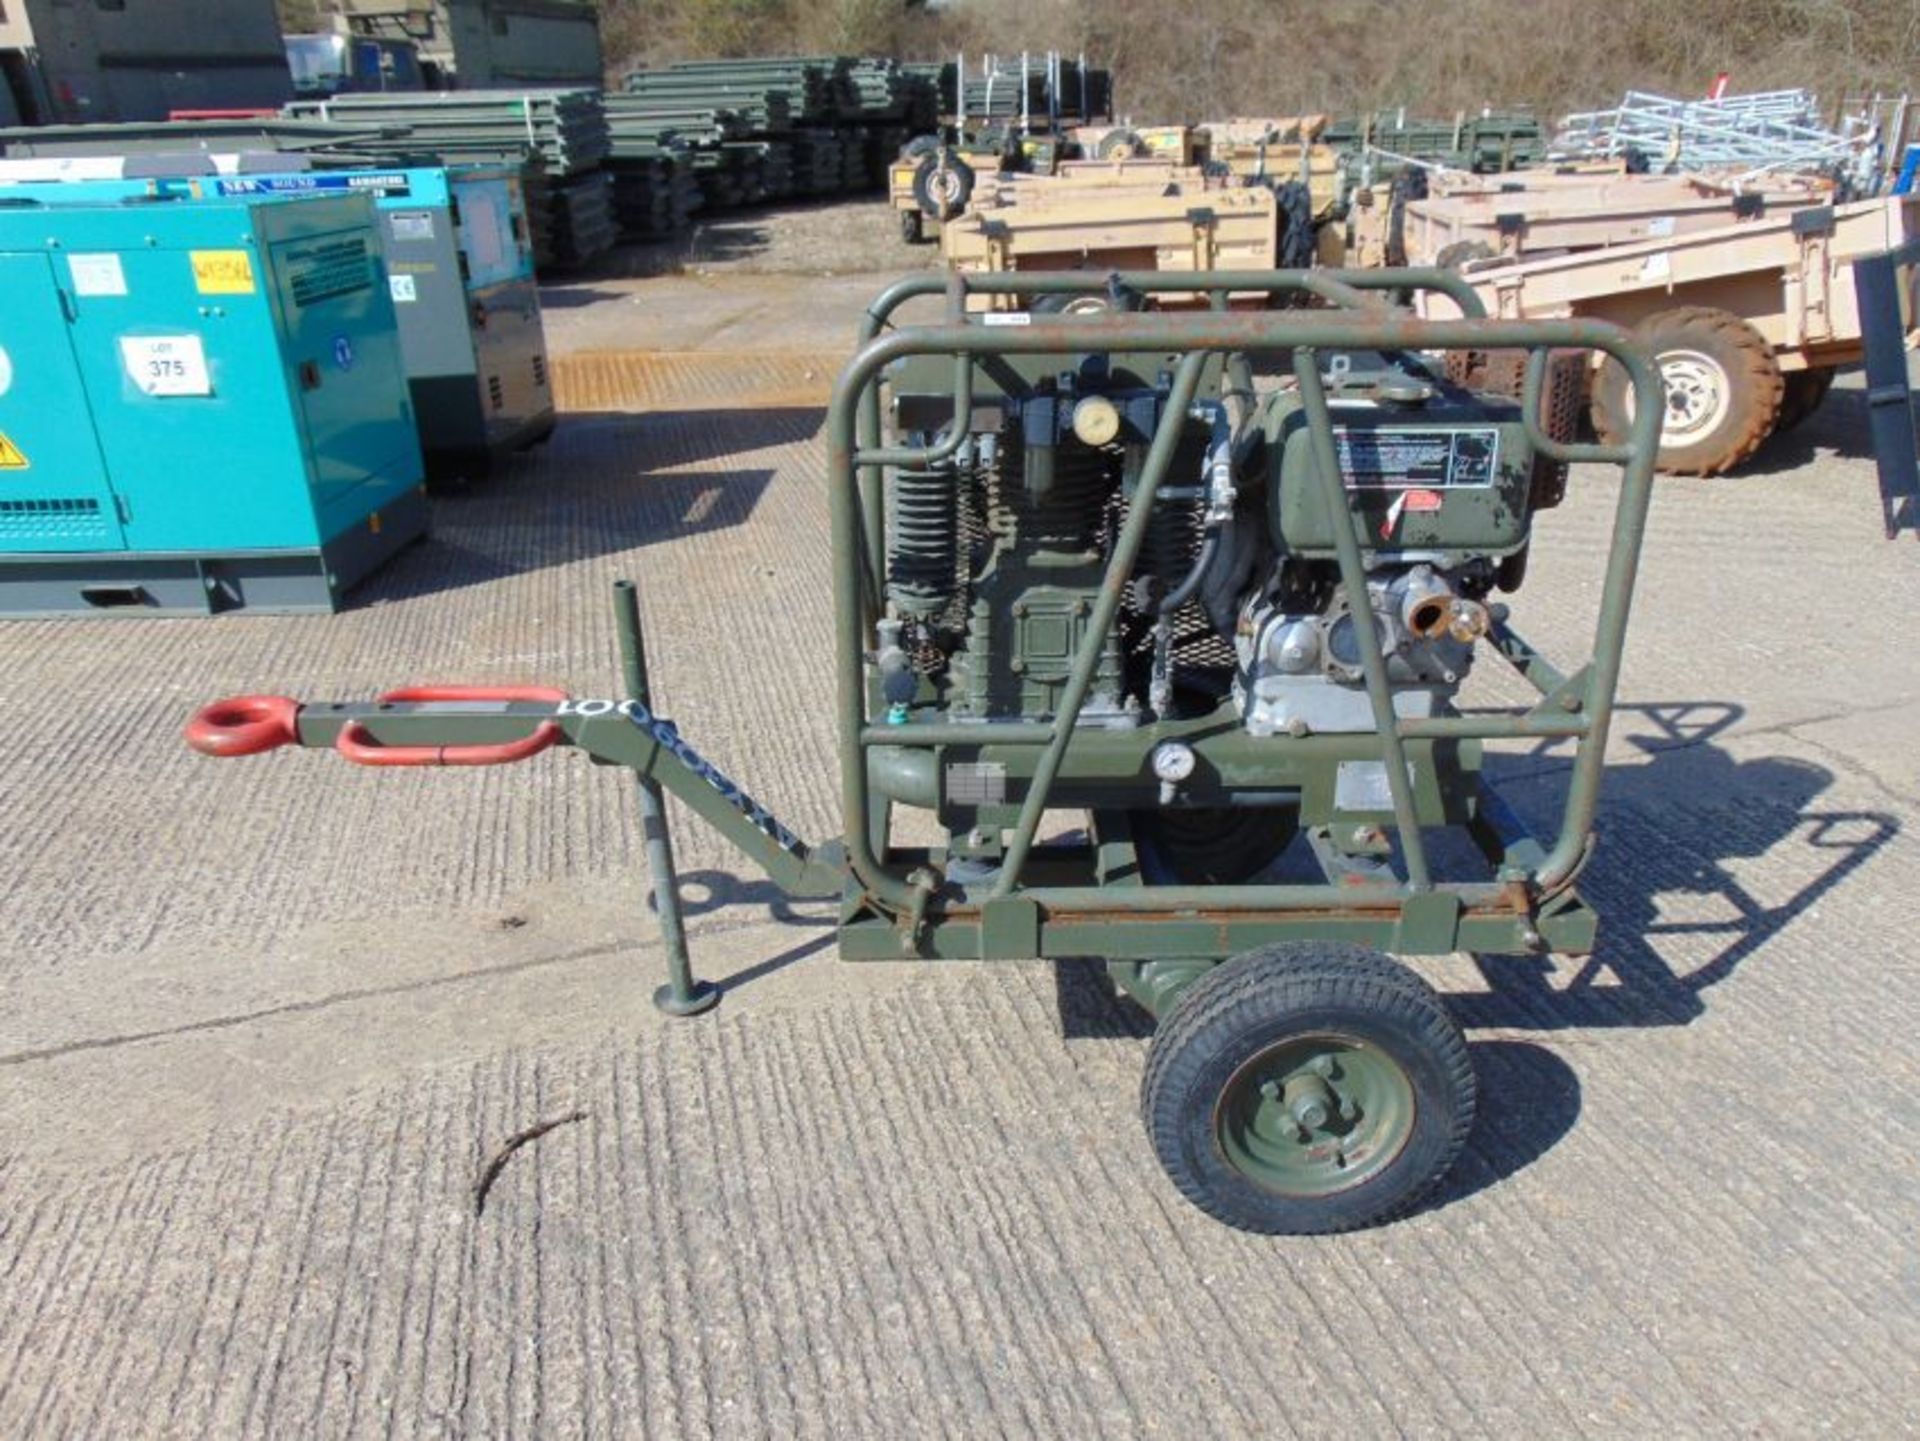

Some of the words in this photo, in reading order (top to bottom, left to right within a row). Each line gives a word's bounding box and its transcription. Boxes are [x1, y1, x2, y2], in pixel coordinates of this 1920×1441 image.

[222, 180, 257, 194] NEW
[149, 343, 173, 353] LOT
[148, 360, 185, 377] 375
